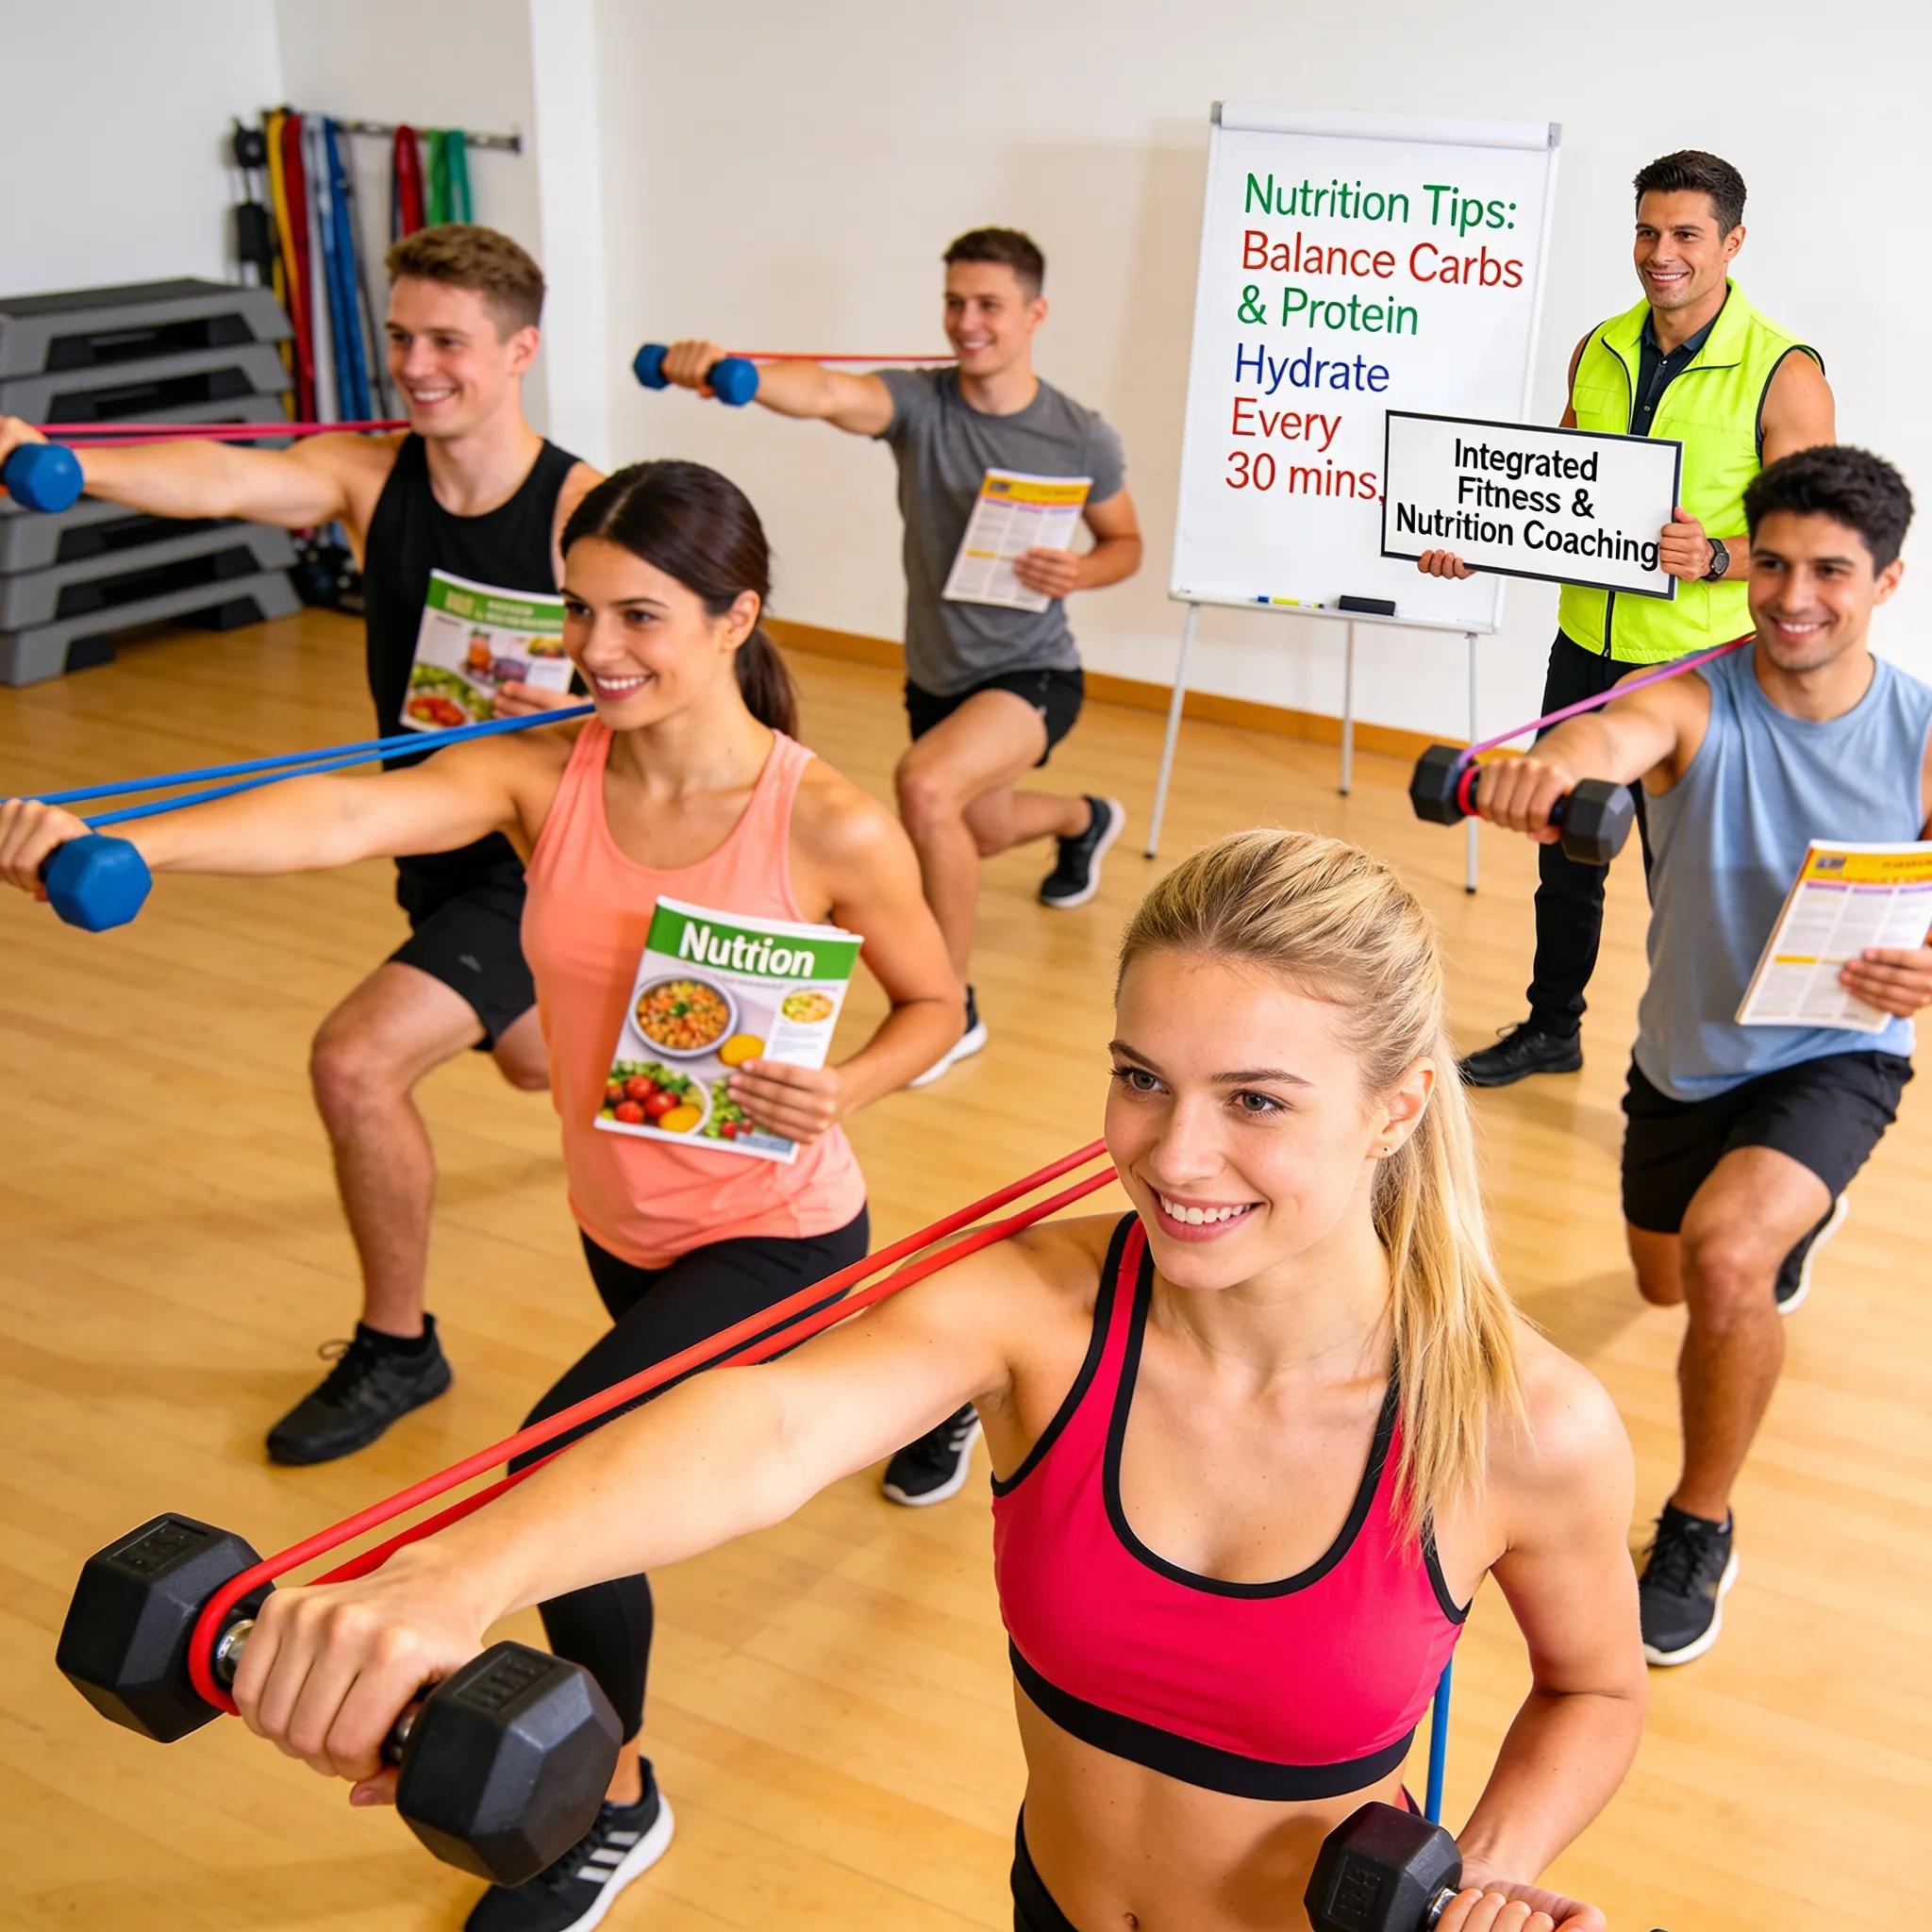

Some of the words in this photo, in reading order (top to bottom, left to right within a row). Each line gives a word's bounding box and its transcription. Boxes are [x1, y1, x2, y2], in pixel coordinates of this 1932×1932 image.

[1245, 174, 1409, 222] Nutrition
[1423, 183, 1518, 238] Tips:
[1241, 228, 1396, 278] Balance
[1407, 241, 1524, 289] Carbs
[1237, 284, 1268, 325] &
[1281, 286, 1419, 336] Protein
[1234, 342, 1391, 395] Hydrate
[1231, 396, 1342, 454] Every
[1224, 449, 1276, 492] 30
[1455, 438, 1599, 482] Integrated
[1457, 475, 1562, 514] Fitness
[1571, 488, 1596, 520] &
[1396, 502, 1514, 546] Nutrition
[1523, 519, 1659, 572] Coaching
